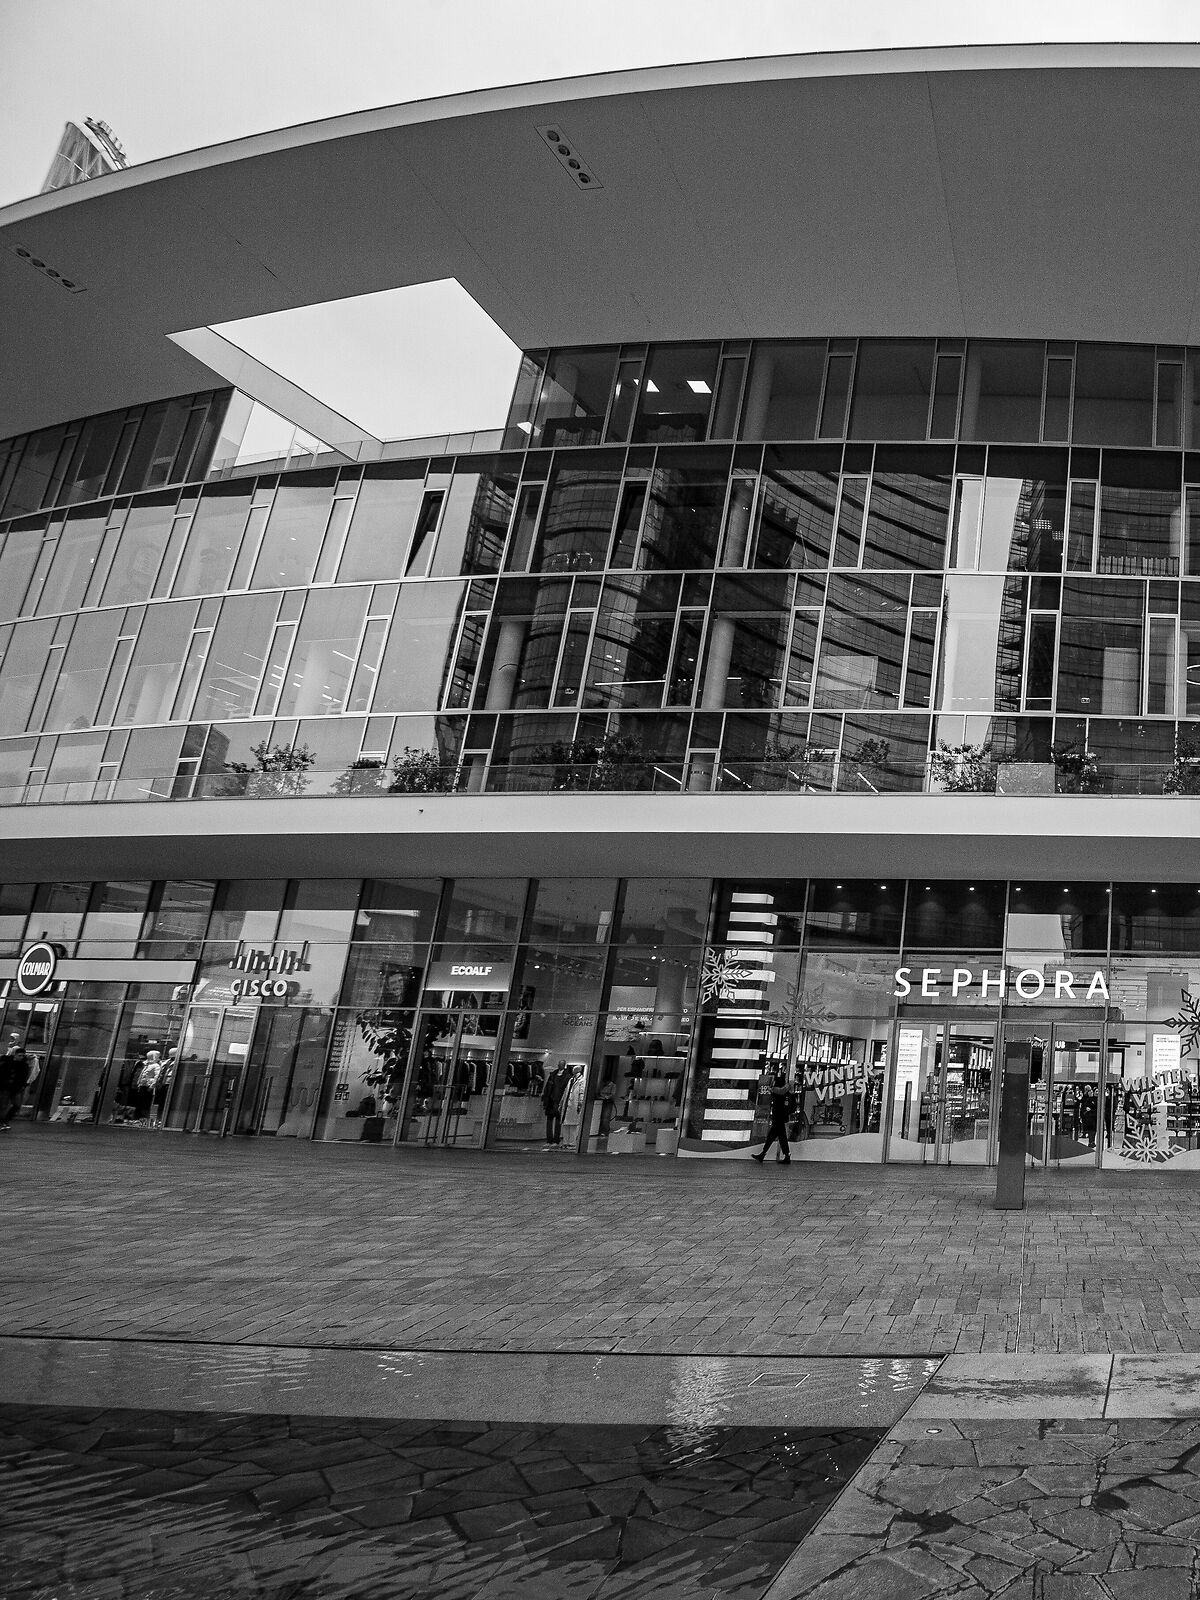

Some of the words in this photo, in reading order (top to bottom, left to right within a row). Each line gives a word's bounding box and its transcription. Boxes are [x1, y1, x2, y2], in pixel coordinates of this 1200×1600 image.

[21, 962, 51, 976] COLMAR
[450, 965, 492, 976] ECOALF
[229, 978, 288, 998] CISCO
[893, 967, 1110, 999] SEPHORA
[804, 1062, 876, 1088] WINTER
[1120, 1067, 1192, 1093] WINTER
[815, 1079, 869, 1101] VIBES
[1132, 1083, 1187, 1109] VIBES
